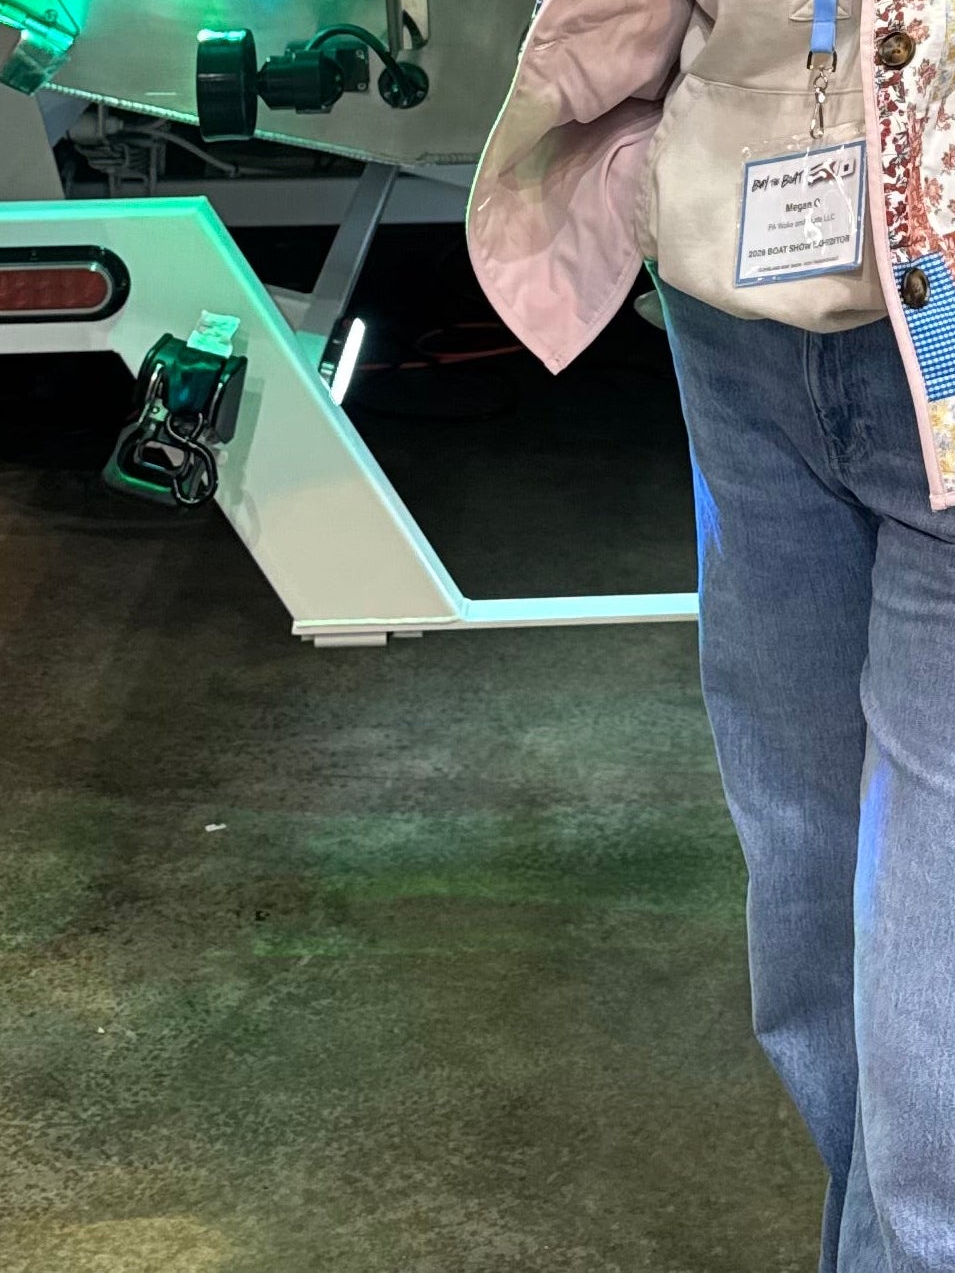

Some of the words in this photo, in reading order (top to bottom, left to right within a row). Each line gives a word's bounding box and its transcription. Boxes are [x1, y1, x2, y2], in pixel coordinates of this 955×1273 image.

[785, 201, 813, 212] Megan
[824, 213, 836, 223] LLC
[767, 245, 788, 256] BOAT
[788, 241, 811, 253] SHOW
